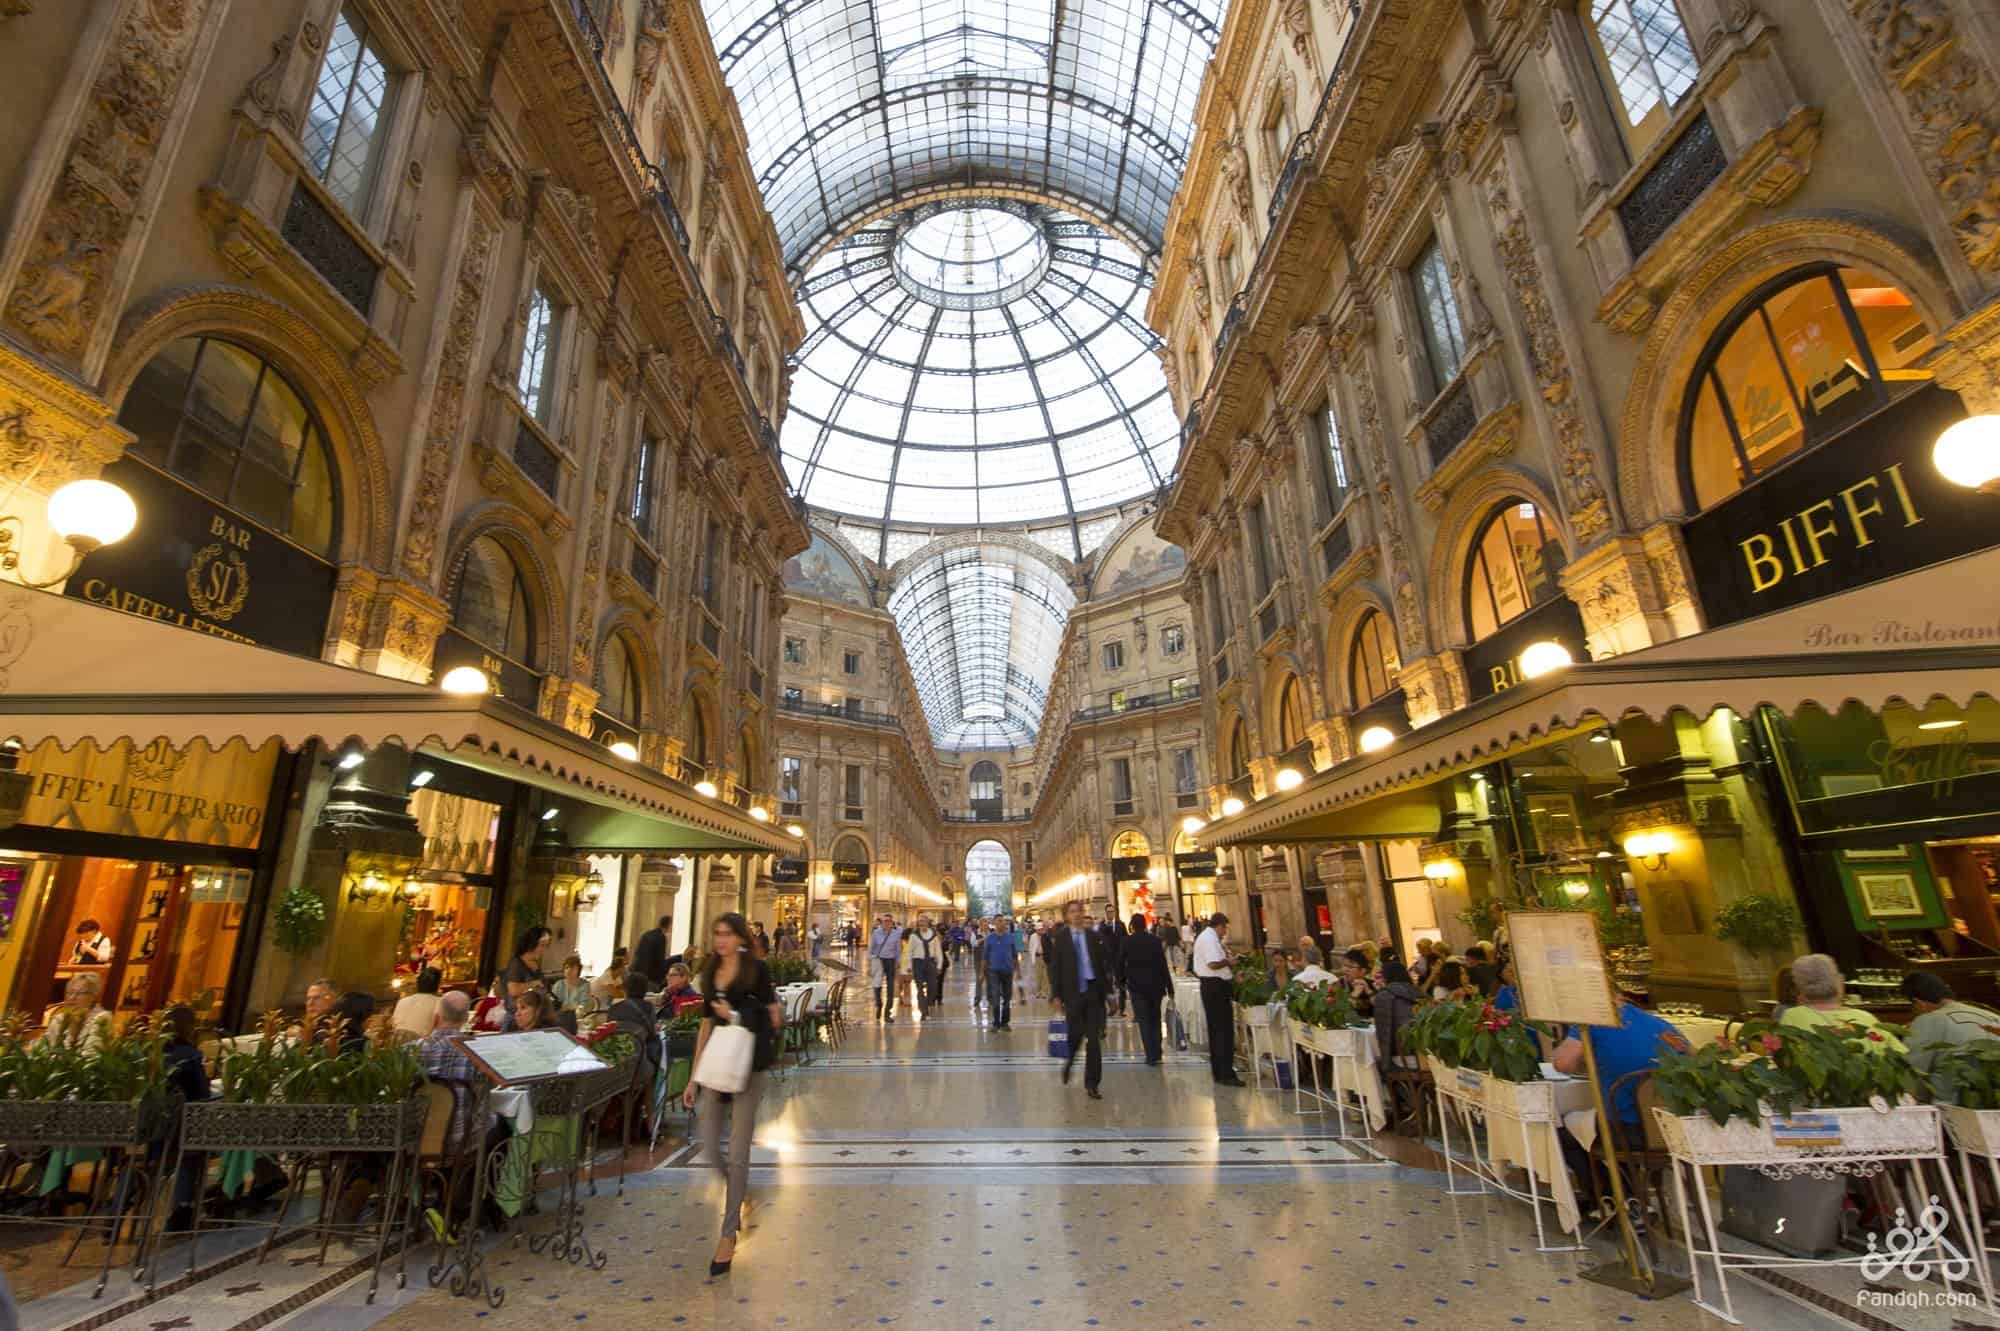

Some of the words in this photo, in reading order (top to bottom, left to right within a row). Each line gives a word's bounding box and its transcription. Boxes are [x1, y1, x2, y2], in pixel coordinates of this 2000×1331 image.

[209, 514, 251, 550] BAR
[1738, 462, 1925, 594] BIFFI
[1803, 623, 1864, 647] Bar
[1872, 615, 2000, 644] Ristoran
[36, 772, 104, 803] FFE'
[107, 783, 261, 826] LETTERARIO
